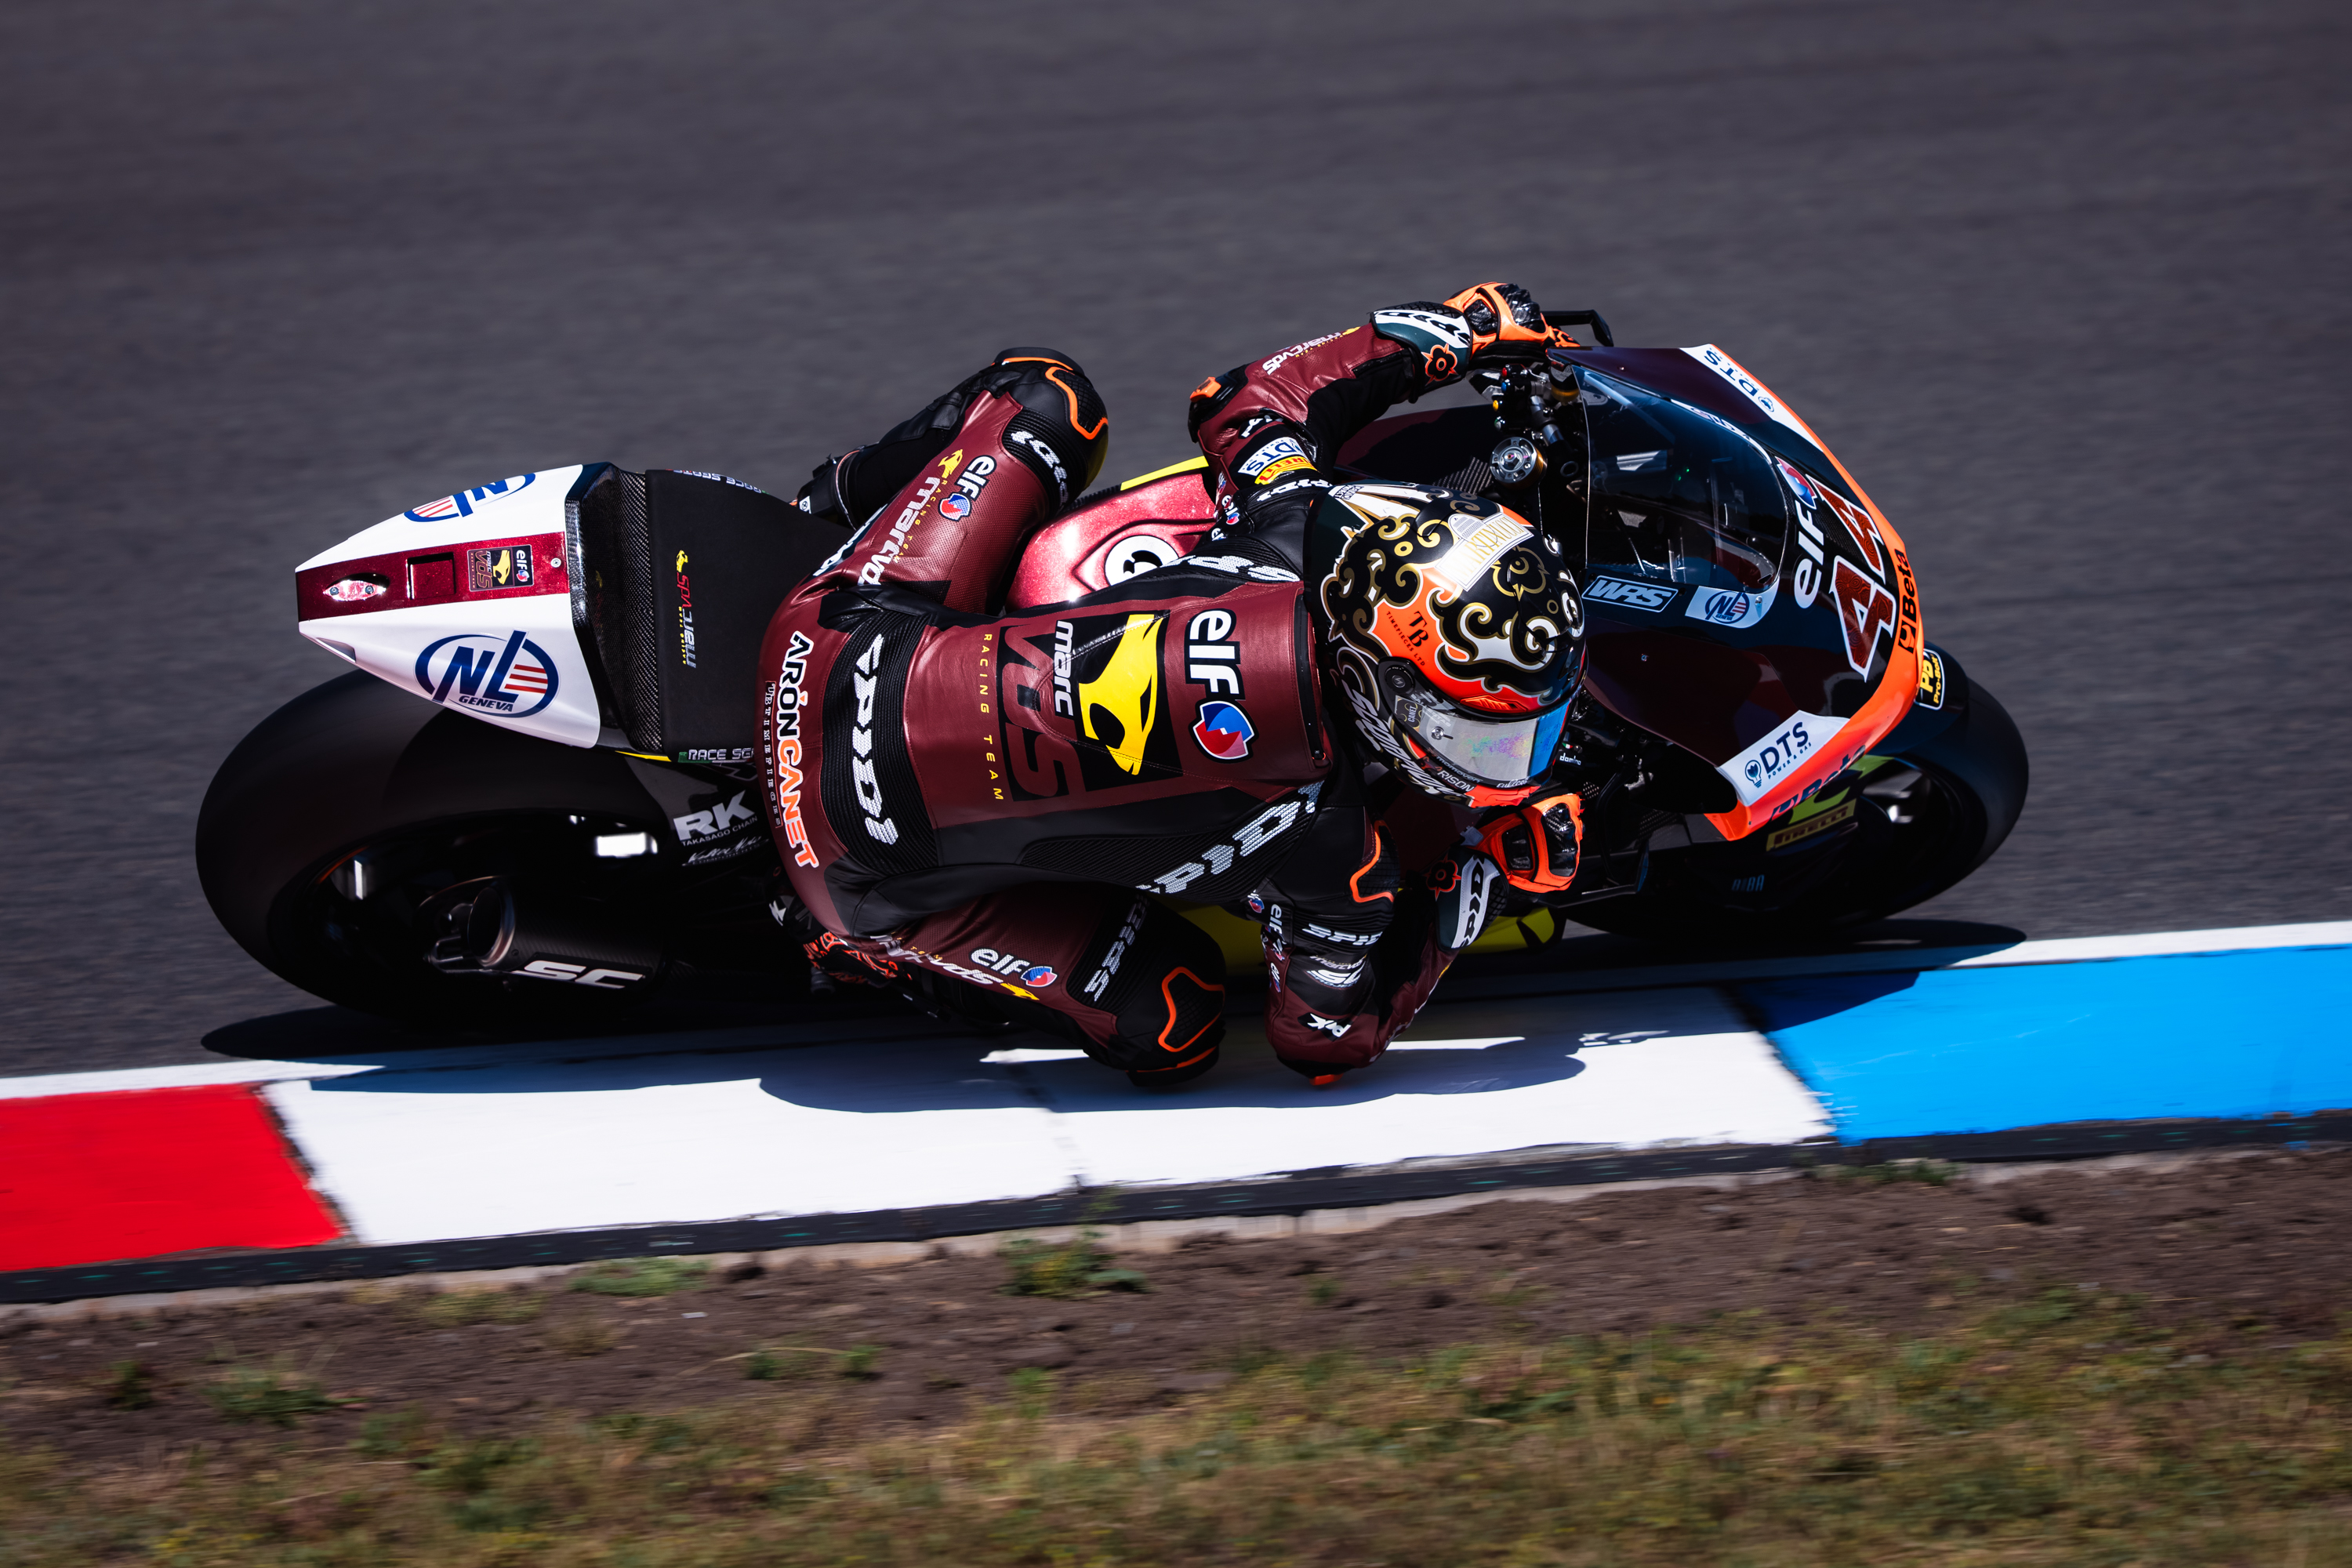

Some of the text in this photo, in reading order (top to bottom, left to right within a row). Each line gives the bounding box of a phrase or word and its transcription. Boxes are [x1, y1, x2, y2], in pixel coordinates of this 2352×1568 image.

[1704, 350, 1758, 396] DTS
[1247, 442, 1296, 472] DTS
[957, 456, 995, 499] elf
[516, 550, 528, 570] elf
[1794, 499, 1824, 609] elf
[1588, 579, 1671, 607] WRS
[1386, 611, 1414, 652] TIMEPIECES
[1414, 653, 1425, 666] LTD
[1409, 611, 1428, 647] TB
[432, 630, 519, 704] NL
[1054, 620, 1073, 717] marc
[1189, 610, 1240, 695] elf
[459, 695, 514, 712] GENEVA
[979, 633, 1004, 800] RACING TEAM
[688, 749, 727, 760] RACE
[1760, 722, 1809, 774] DTS
[1437, 770, 1475, 792] RISON
[1768, 757, 1792, 779] POWER
[673, 789, 755, 841] RK
[682, 815, 758, 847] TAKASAGO CHAIN
[1269, 904, 1283, 935] elf
[511, 960, 644, 989] SC
[971, 949, 1030, 975] elf
